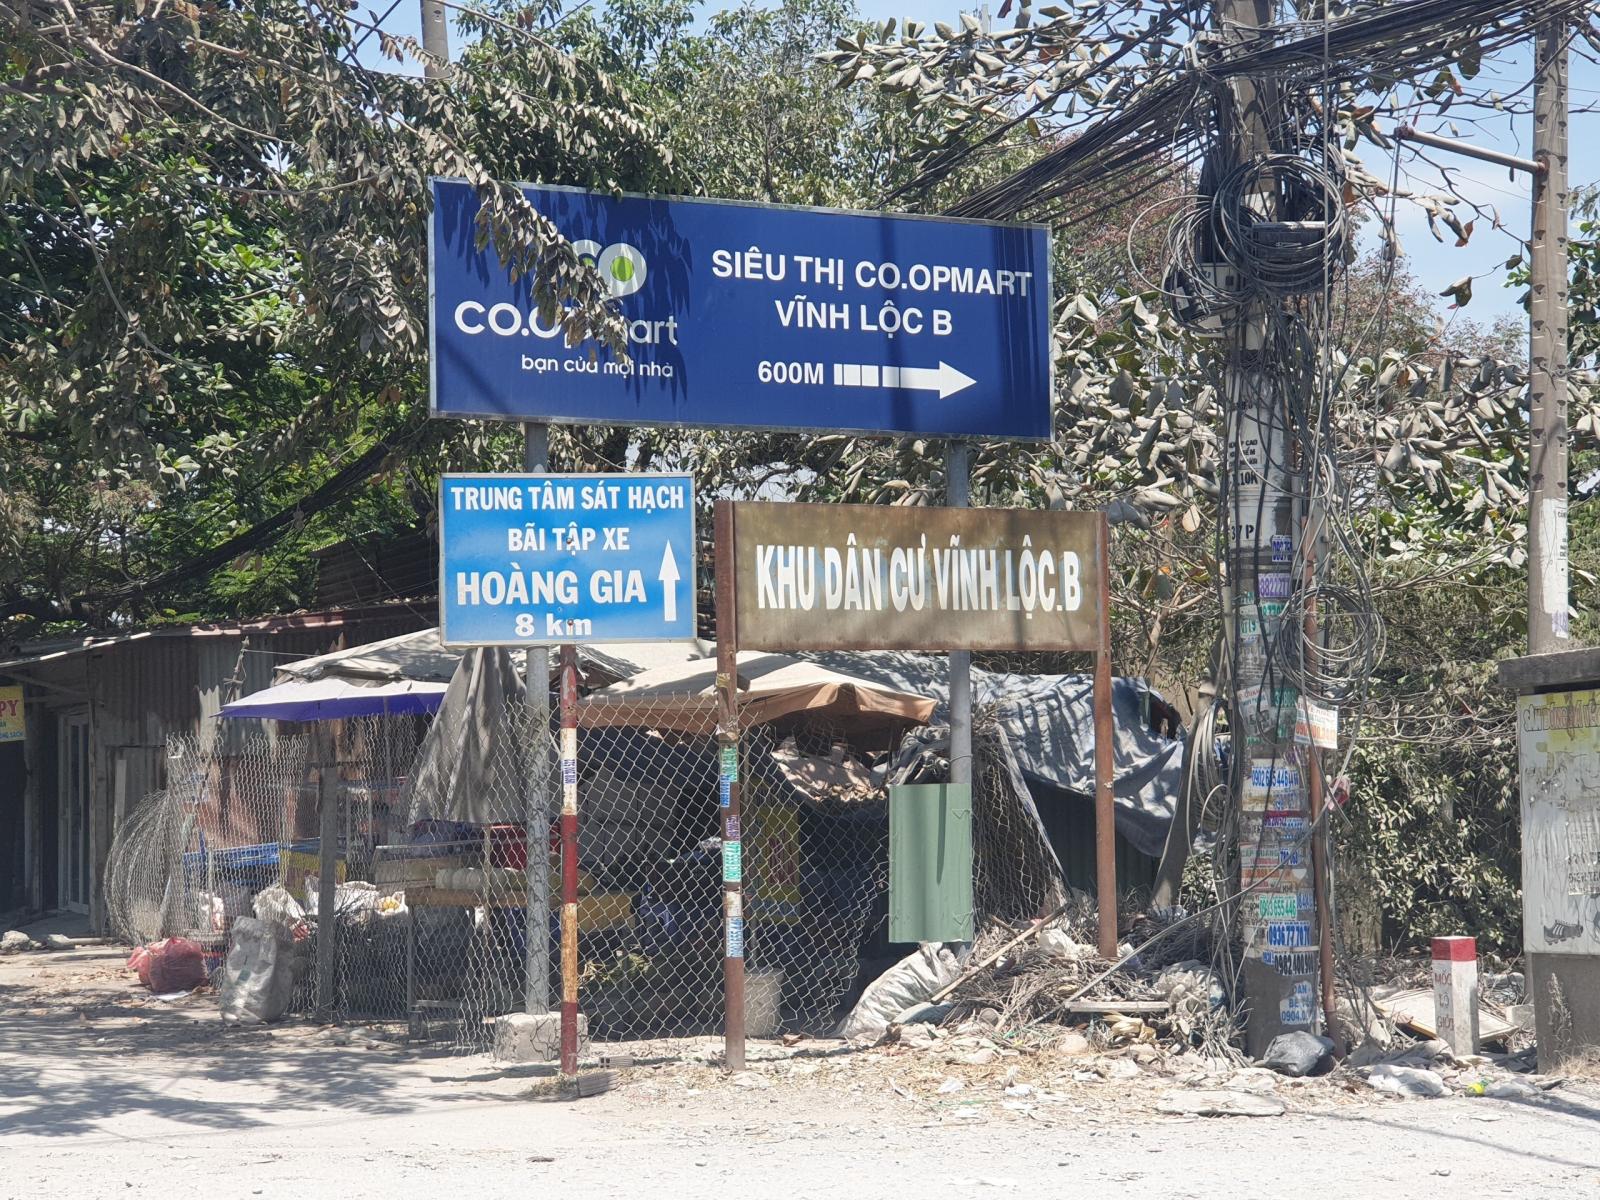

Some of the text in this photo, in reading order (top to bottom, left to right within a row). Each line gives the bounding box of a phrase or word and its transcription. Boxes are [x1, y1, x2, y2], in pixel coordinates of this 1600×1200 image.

[711, 245, 1033, 297] SIÊU THỊ CO.OPMART
[775, 294, 953, 338] VĨNH LỘC B
[521, 354, 558, 374] bạn
[563, 355, 598, 374] của
[639, 361, 674, 378] nhà
[757, 360, 824, 385] 600M
[450, 480, 685, 514] TRUNG TÂM SÁT HẠCH
[508, 521, 630, 556] BÃI TẬP XE
[456, 562, 648, 606] HOÀNG GIA
[756, 544, 815, 611] KHU
[824, 532, 882, 611] DÂN
[890, 532, 926, 612] CƯ
[933, 534, 998, 611] VĨNH
[514, 612, 592, 637] 8 km
